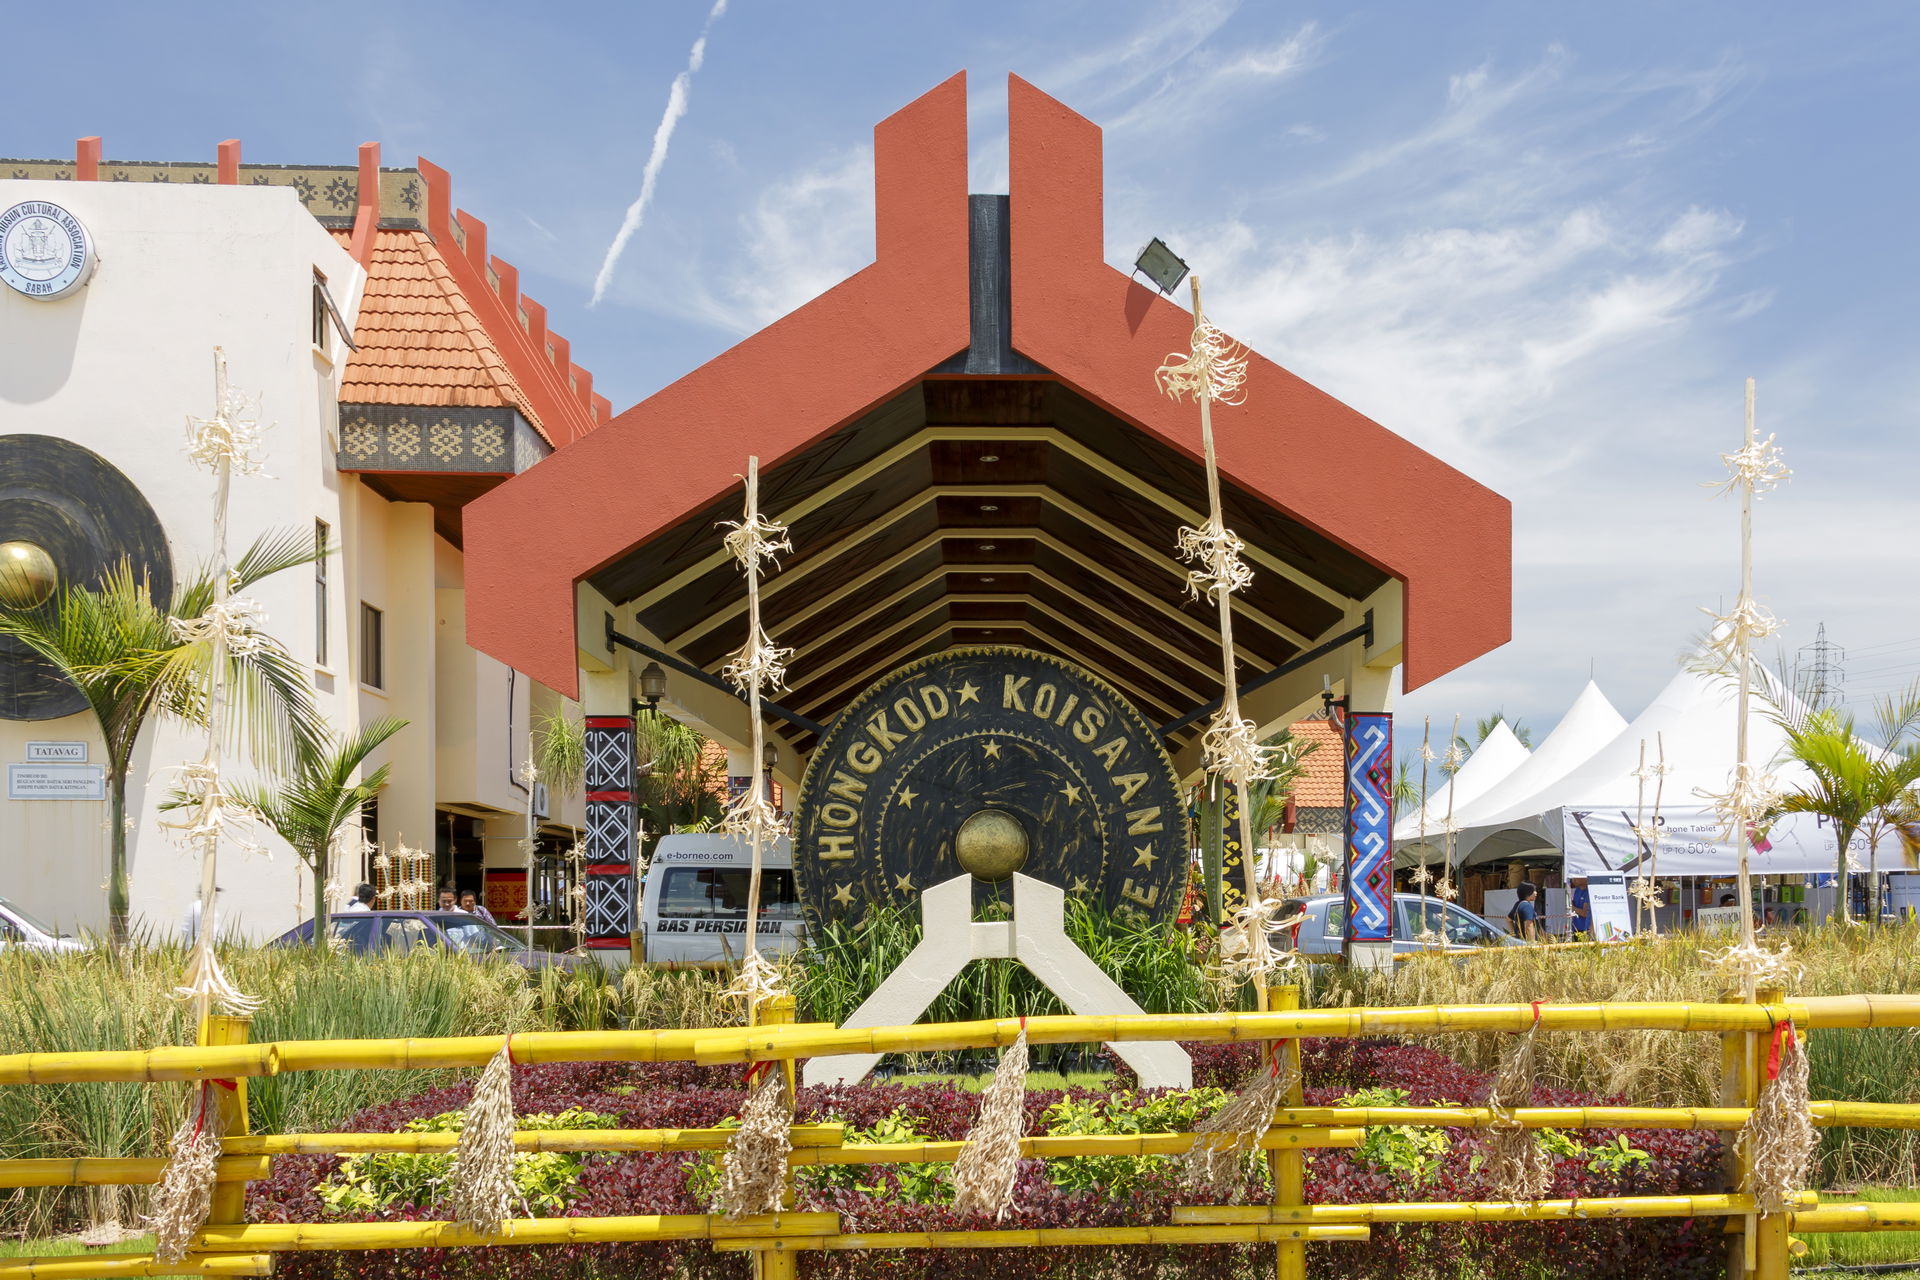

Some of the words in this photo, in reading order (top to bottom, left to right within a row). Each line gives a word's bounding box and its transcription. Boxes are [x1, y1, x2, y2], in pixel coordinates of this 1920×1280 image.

[21, 203, 62, 220] CULTURAL
[61, 216, 83, 270] ASSOCIATION
[25, 282, 53, 294] SABAH
[34, 747, 79, 756] TATAVAG
[818, 684, 949, 862] HONGKOD
[1003, 674, 1164, 837] KOISAAN
[1690, 824, 1717, 832] Tablet
[1662, 847, 1673, 855] UP
[1687, 842, 1717, 855] 50%
[666, 851, 734, 862] e-borneo.com
[1713, 911, 1741, 926] PARKIN
[656, 920, 690, 932] BAS
